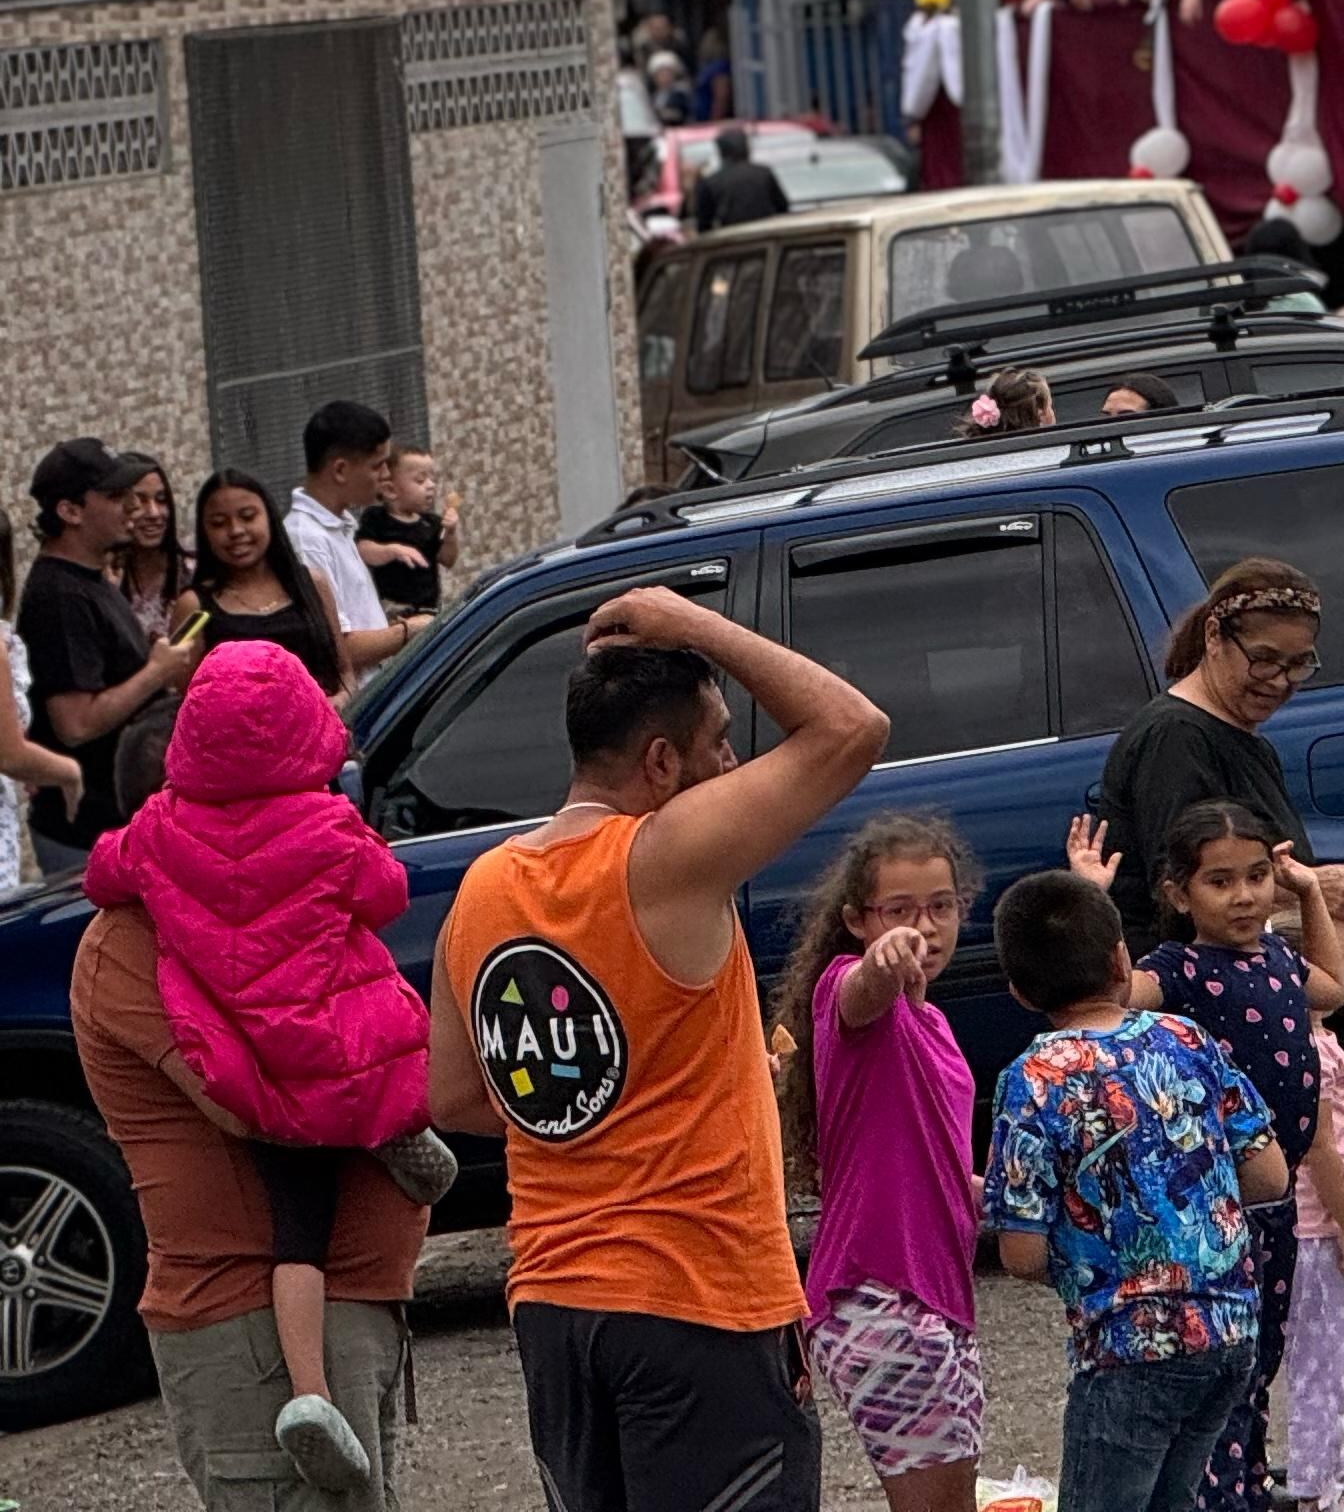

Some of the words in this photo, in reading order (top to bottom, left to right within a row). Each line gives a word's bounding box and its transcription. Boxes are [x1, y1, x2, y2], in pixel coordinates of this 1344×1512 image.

[481, 1013, 610, 1061] MAUI
[535, 1104, 579, 1135] and
[575, 1079, 616, 1122] Sons
